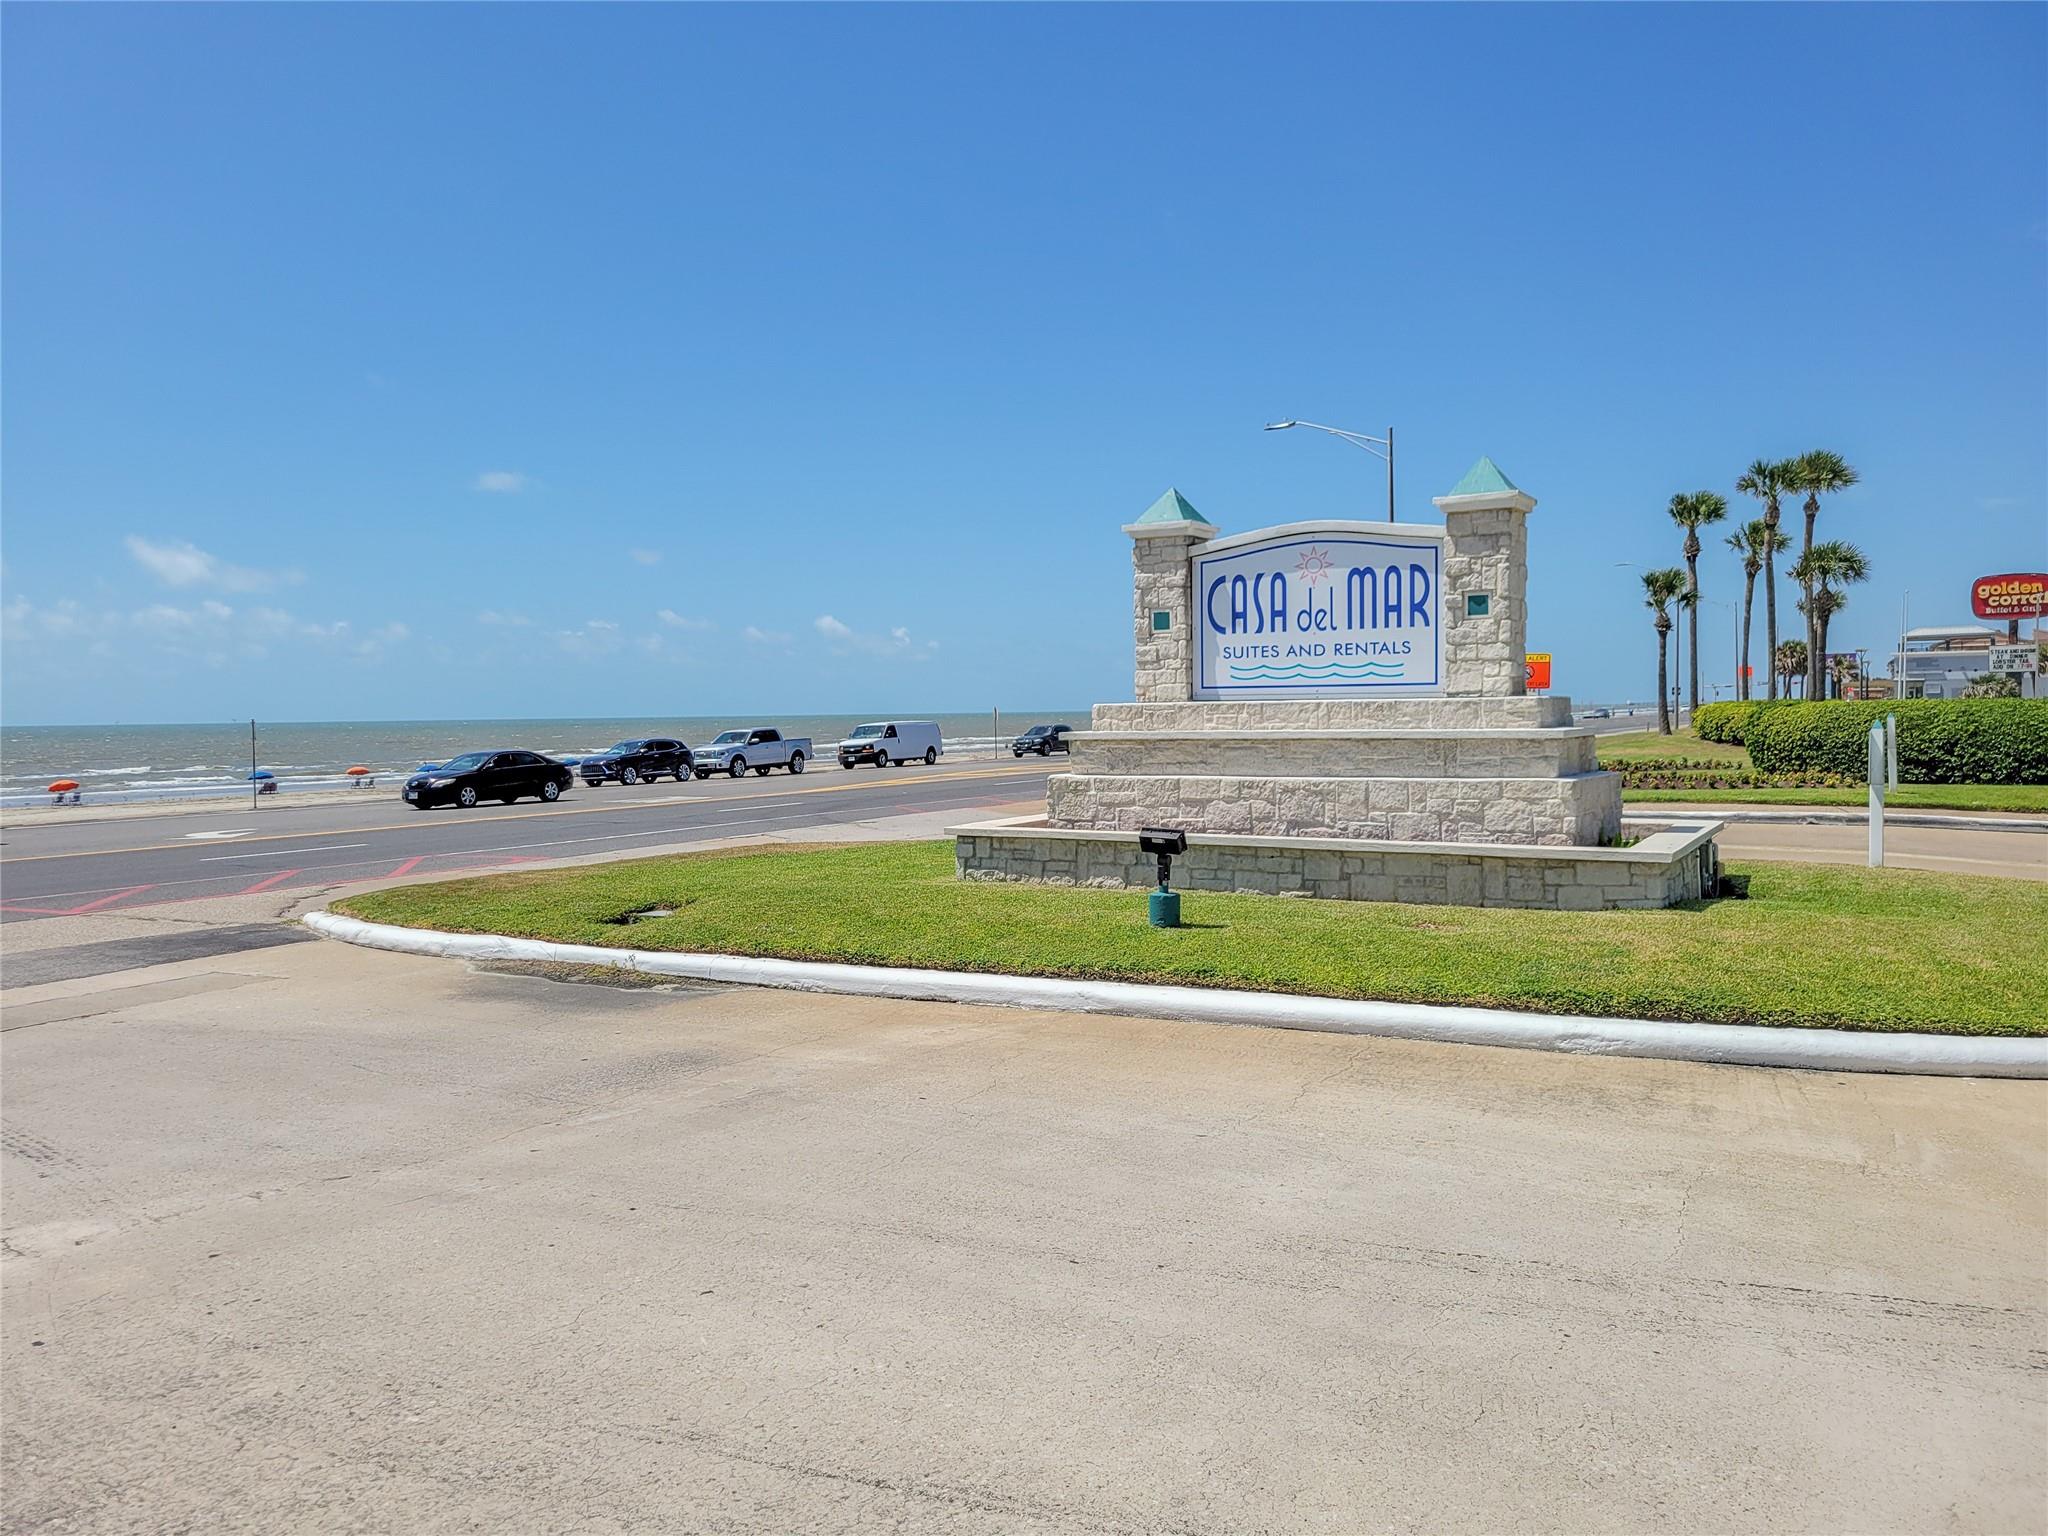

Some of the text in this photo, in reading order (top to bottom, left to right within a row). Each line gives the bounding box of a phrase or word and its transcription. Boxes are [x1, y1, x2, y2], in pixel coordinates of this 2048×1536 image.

[1207, 563, 1430, 635] CASA del MAR
[1977, 581, 2043, 599] golden
[1985, 606, 2012, 614] Buffet
[1223, 640, 1412, 660] SUITES AND RENTALS
